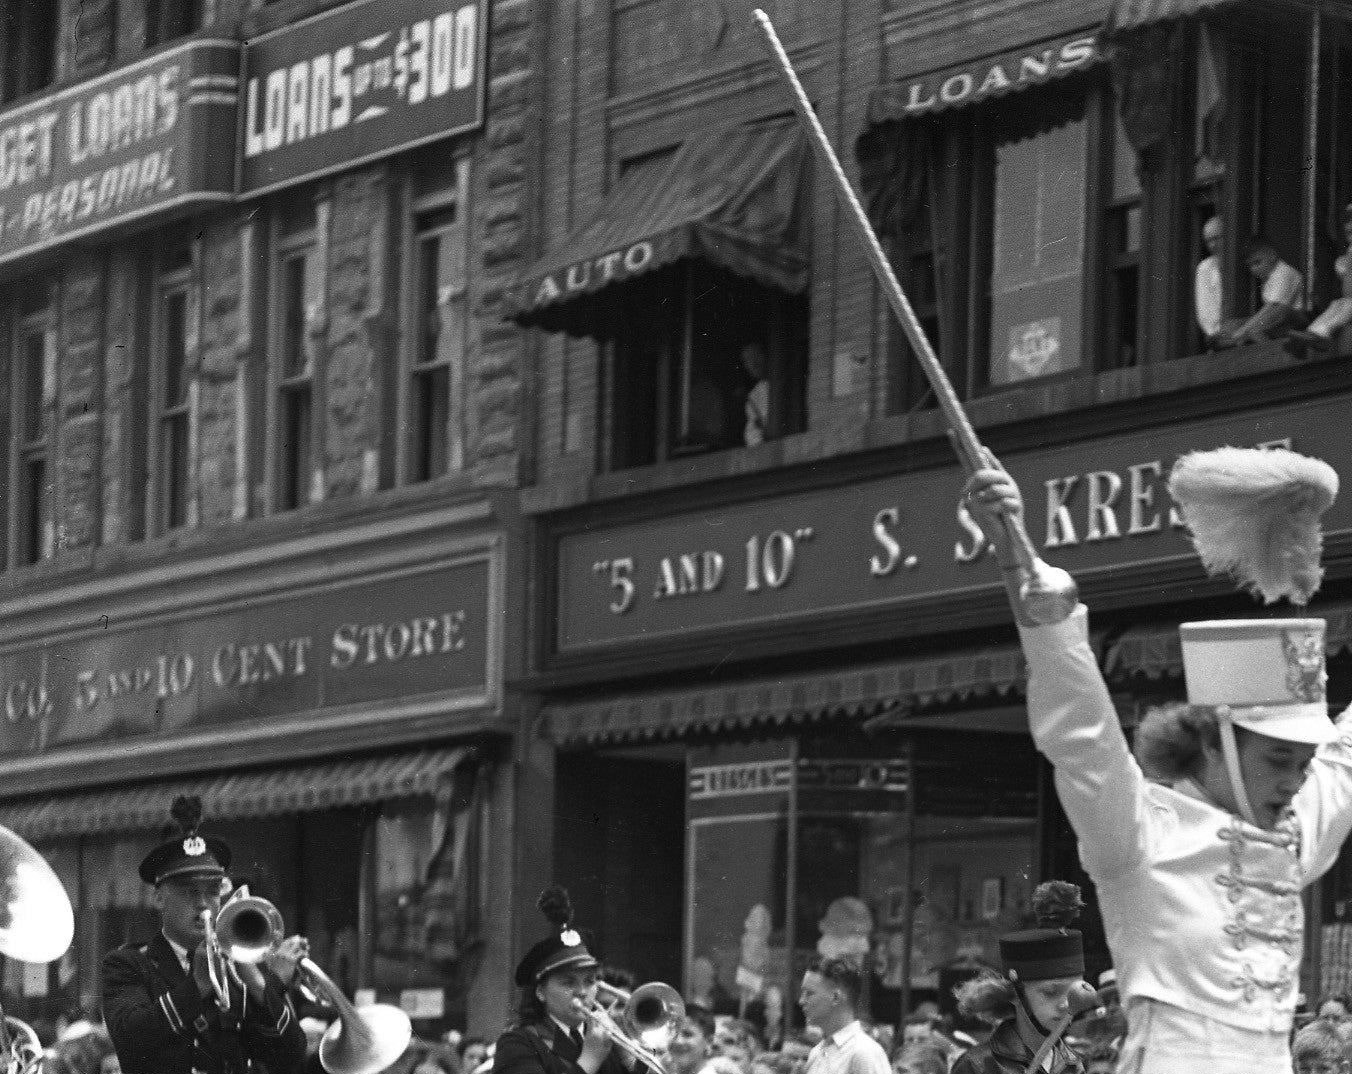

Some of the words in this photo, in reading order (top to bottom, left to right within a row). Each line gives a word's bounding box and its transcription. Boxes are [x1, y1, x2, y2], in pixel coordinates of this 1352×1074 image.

[68, 65, 181, 165] LOANS
[245, 45, 354, 157] LOANS
[393, 3, 478, 106] $300
[904, 36, 1096, 112] LOANS
[535, 242, 654, 303] AUTO
[653, 551, 724, 599] AND
[870, 507, 918, 575] S.
[1044, 437, 1296, 549] KRE
[158, 653, 194, 698] 10
[329, 608, 465, 670] STORE
